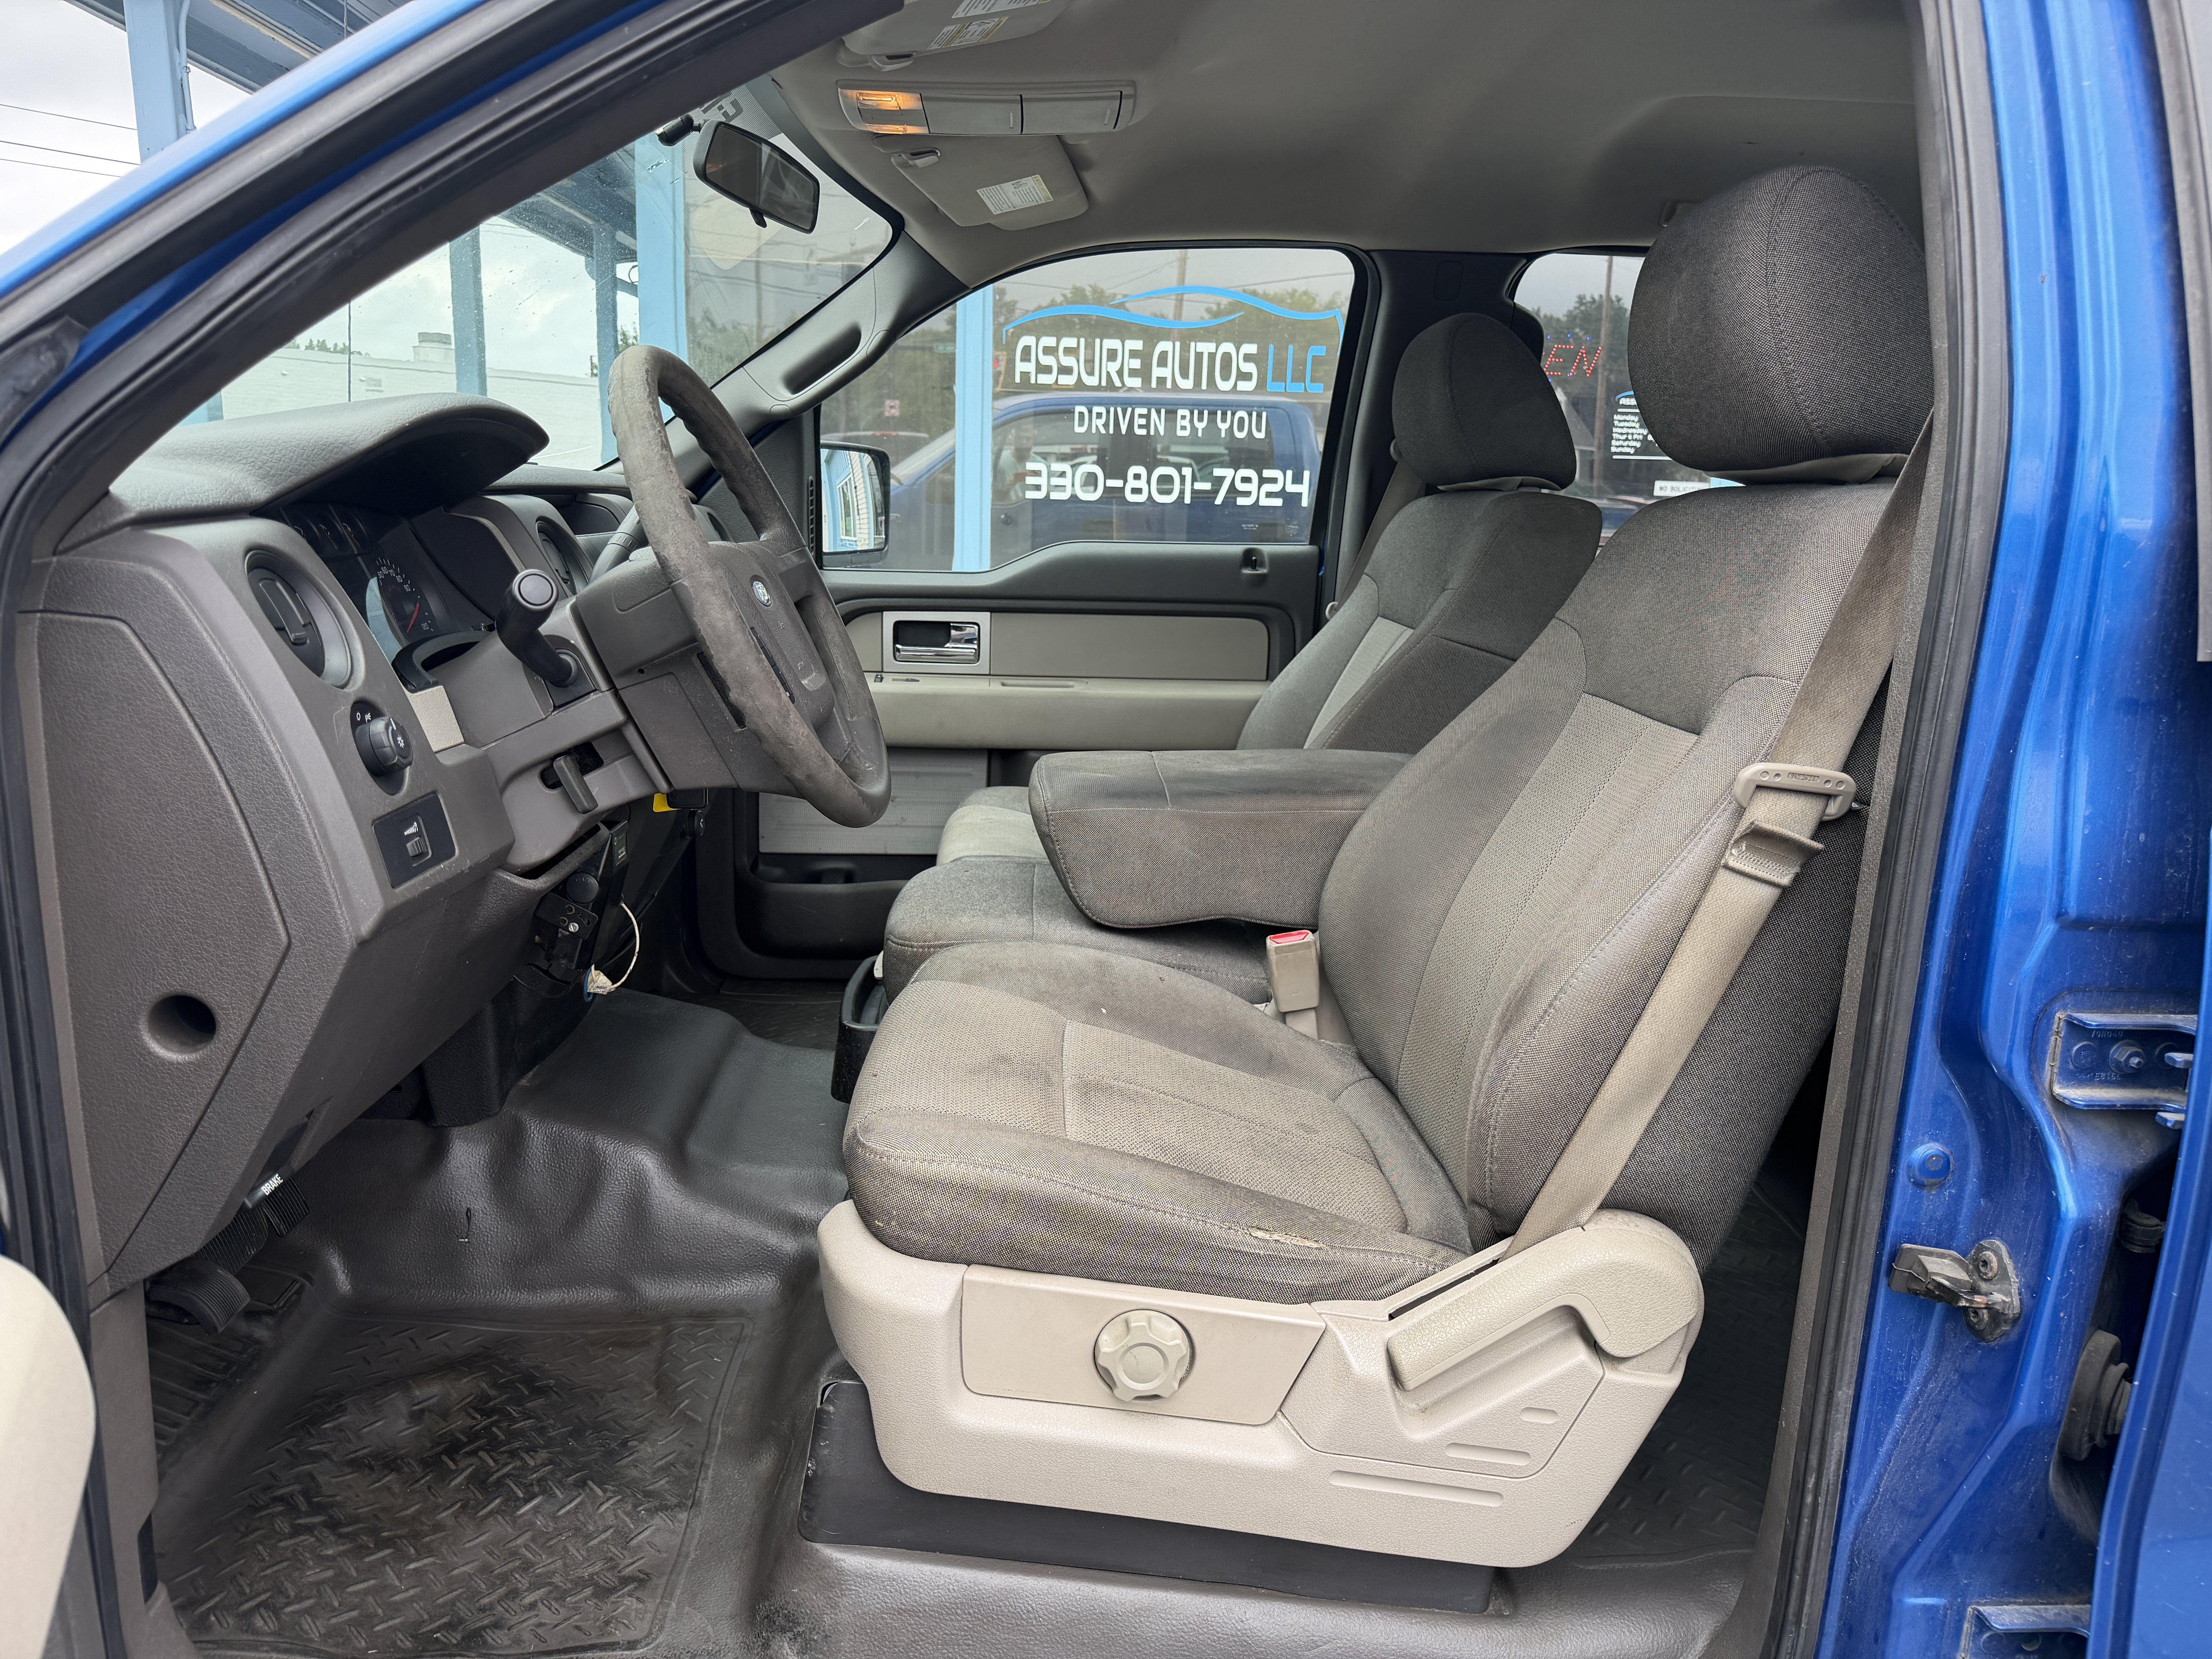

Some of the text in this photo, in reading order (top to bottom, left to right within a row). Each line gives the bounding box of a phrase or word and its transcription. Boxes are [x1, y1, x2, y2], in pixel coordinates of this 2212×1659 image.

[1015, 335, 1326, 393] ASSURE AUTOS LLC
[1543, 344, 1602, 377] EN
[1074, 405, 1267, 439] DRIVEN BY YOU
[1613, 420, 1640, 428] Tuesday
[1614, 414, 1639, 422] Monday
[1611, 440, 1641, 448] Saturday
[1025, 462, 1310, 507] 330-801-7924
[261, 1174, 283, 1195] BRAKE
